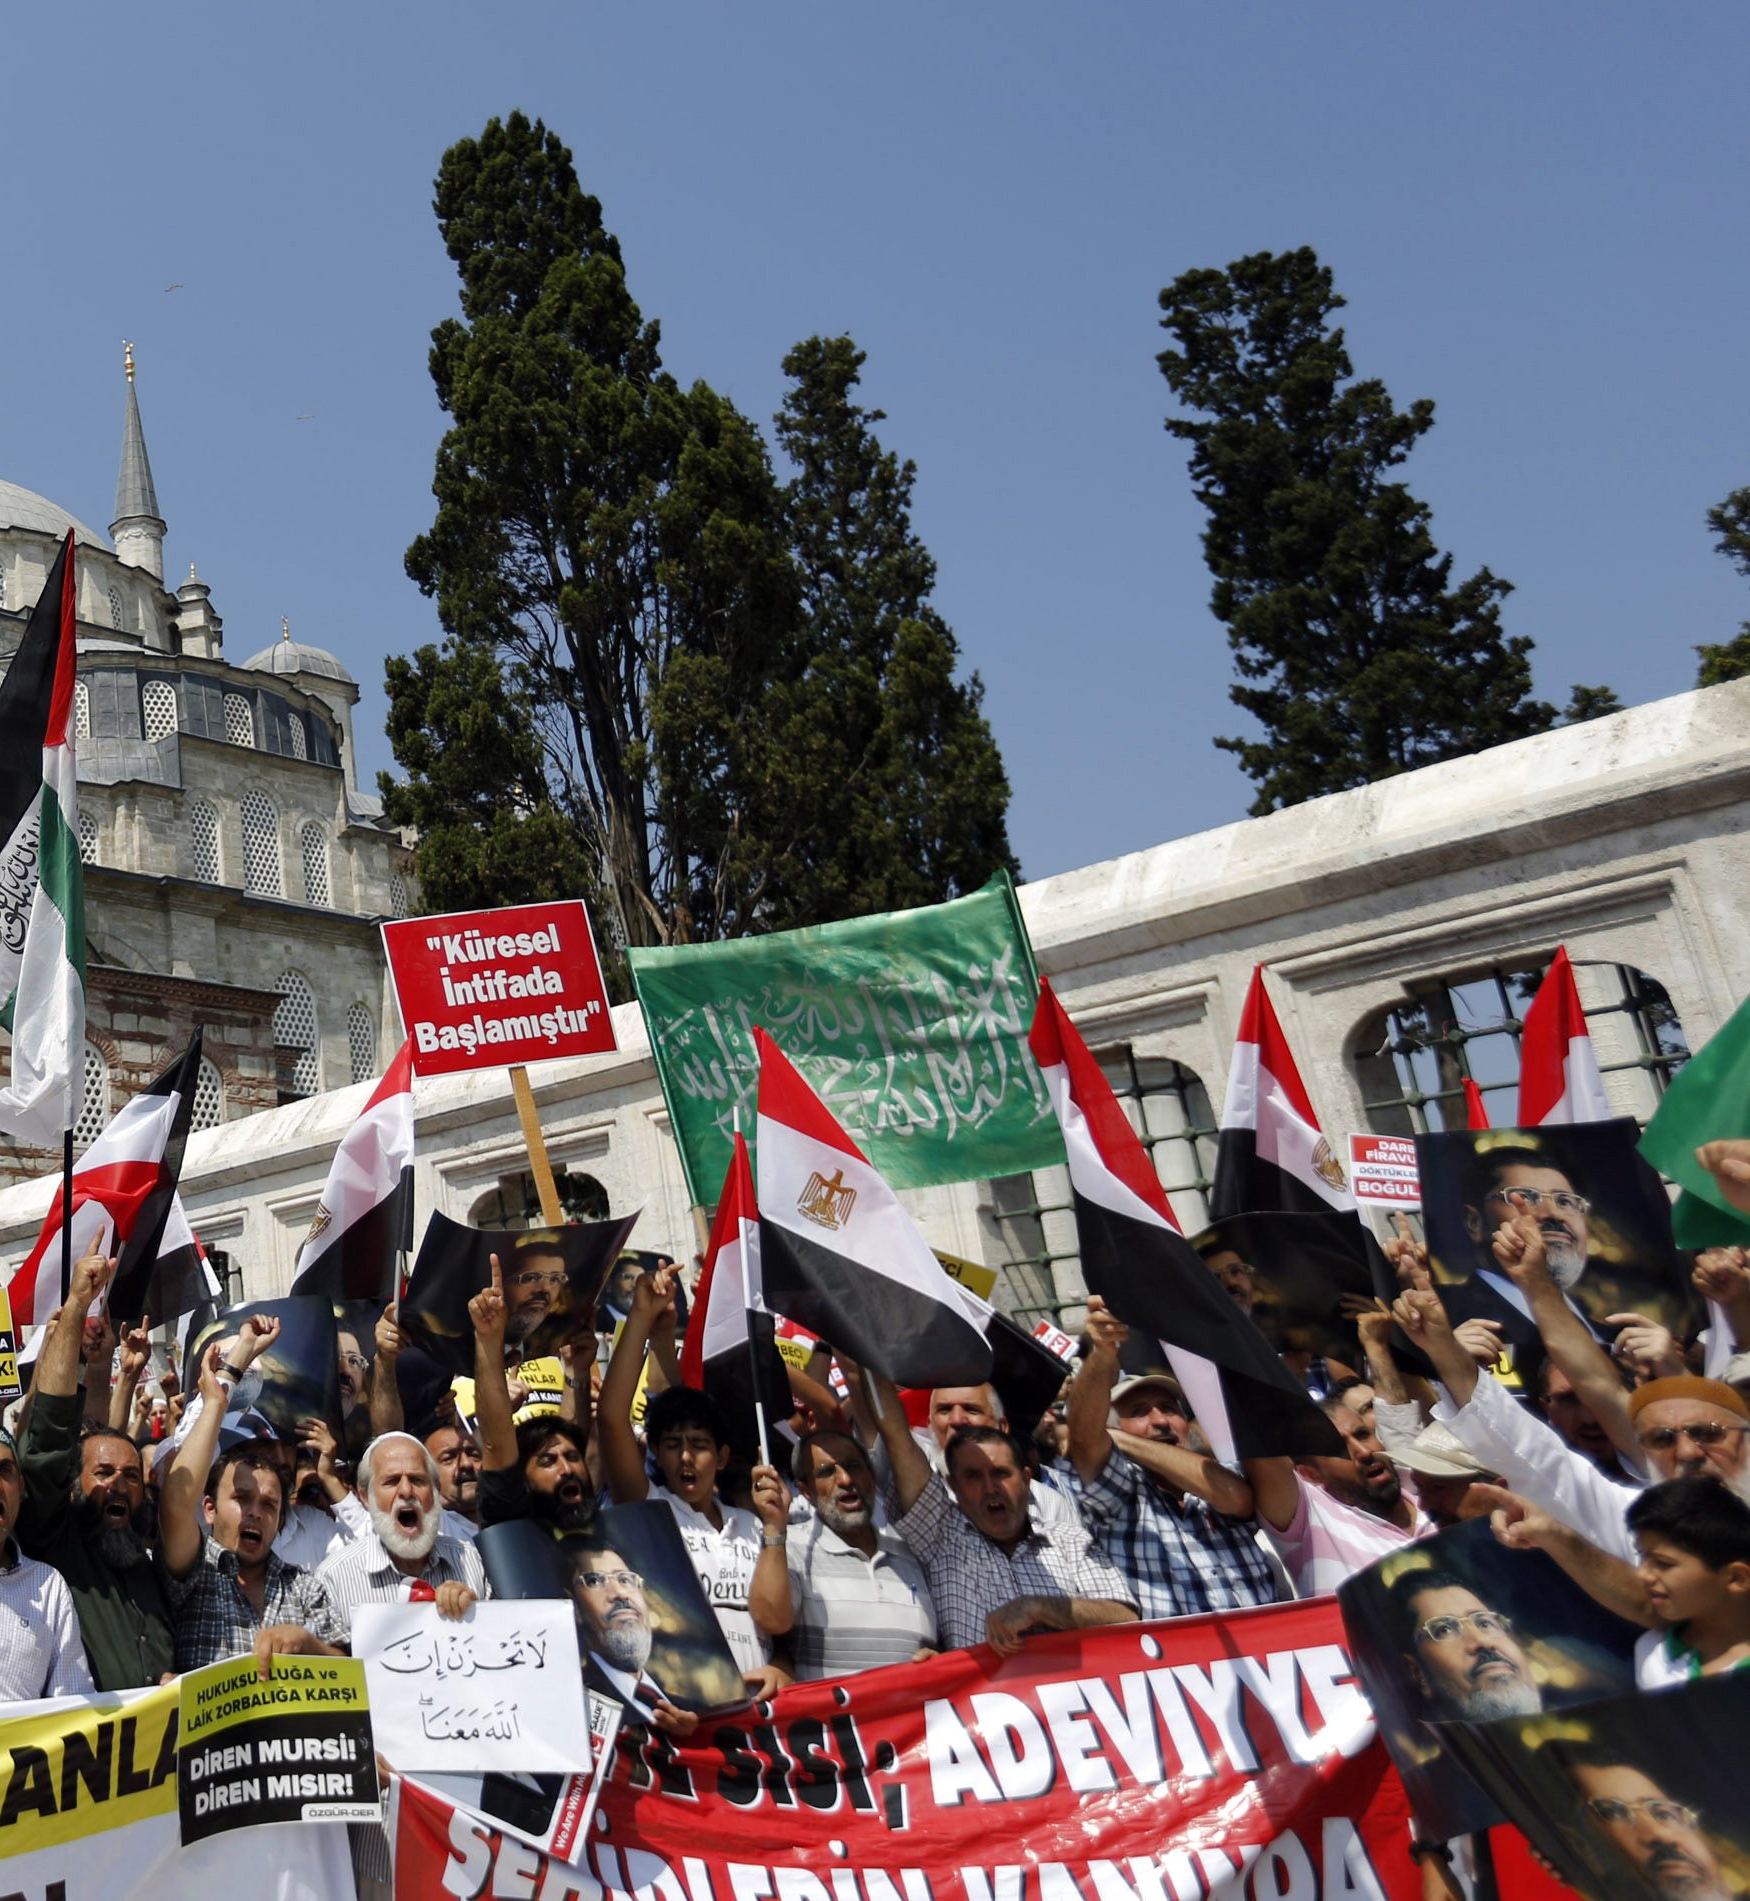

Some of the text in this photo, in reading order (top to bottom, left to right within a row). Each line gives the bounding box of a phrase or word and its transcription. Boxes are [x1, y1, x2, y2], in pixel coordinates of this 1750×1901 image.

[426, 922, 561, 965] "Küresel
[439, 965, 564, 1007] İntifada
[414, 1000, 600, 1056] Başlamıştır"
[1358, 1180, 1420, 1196] BOĞUL
[196, 1665, 338, 1705] HUKUKSULUĞA ve
[187, 1686, 358, 1732] LAİK ZORBALIĞA KARŞI
[924, 1633, 1377, 1807] ADEVİYYE
[190, 1732, 357, 1781] DİREN MURSİ!
[195, 1774, 354, 1816] DİREN MISIR!
[308, 1807, 375, 1817] ÖZGÜR-DER
[567, 1784, 584, 1812] With
[554, 1828, 570, 1849] We
[561, 1810, 576, 1830] Are
